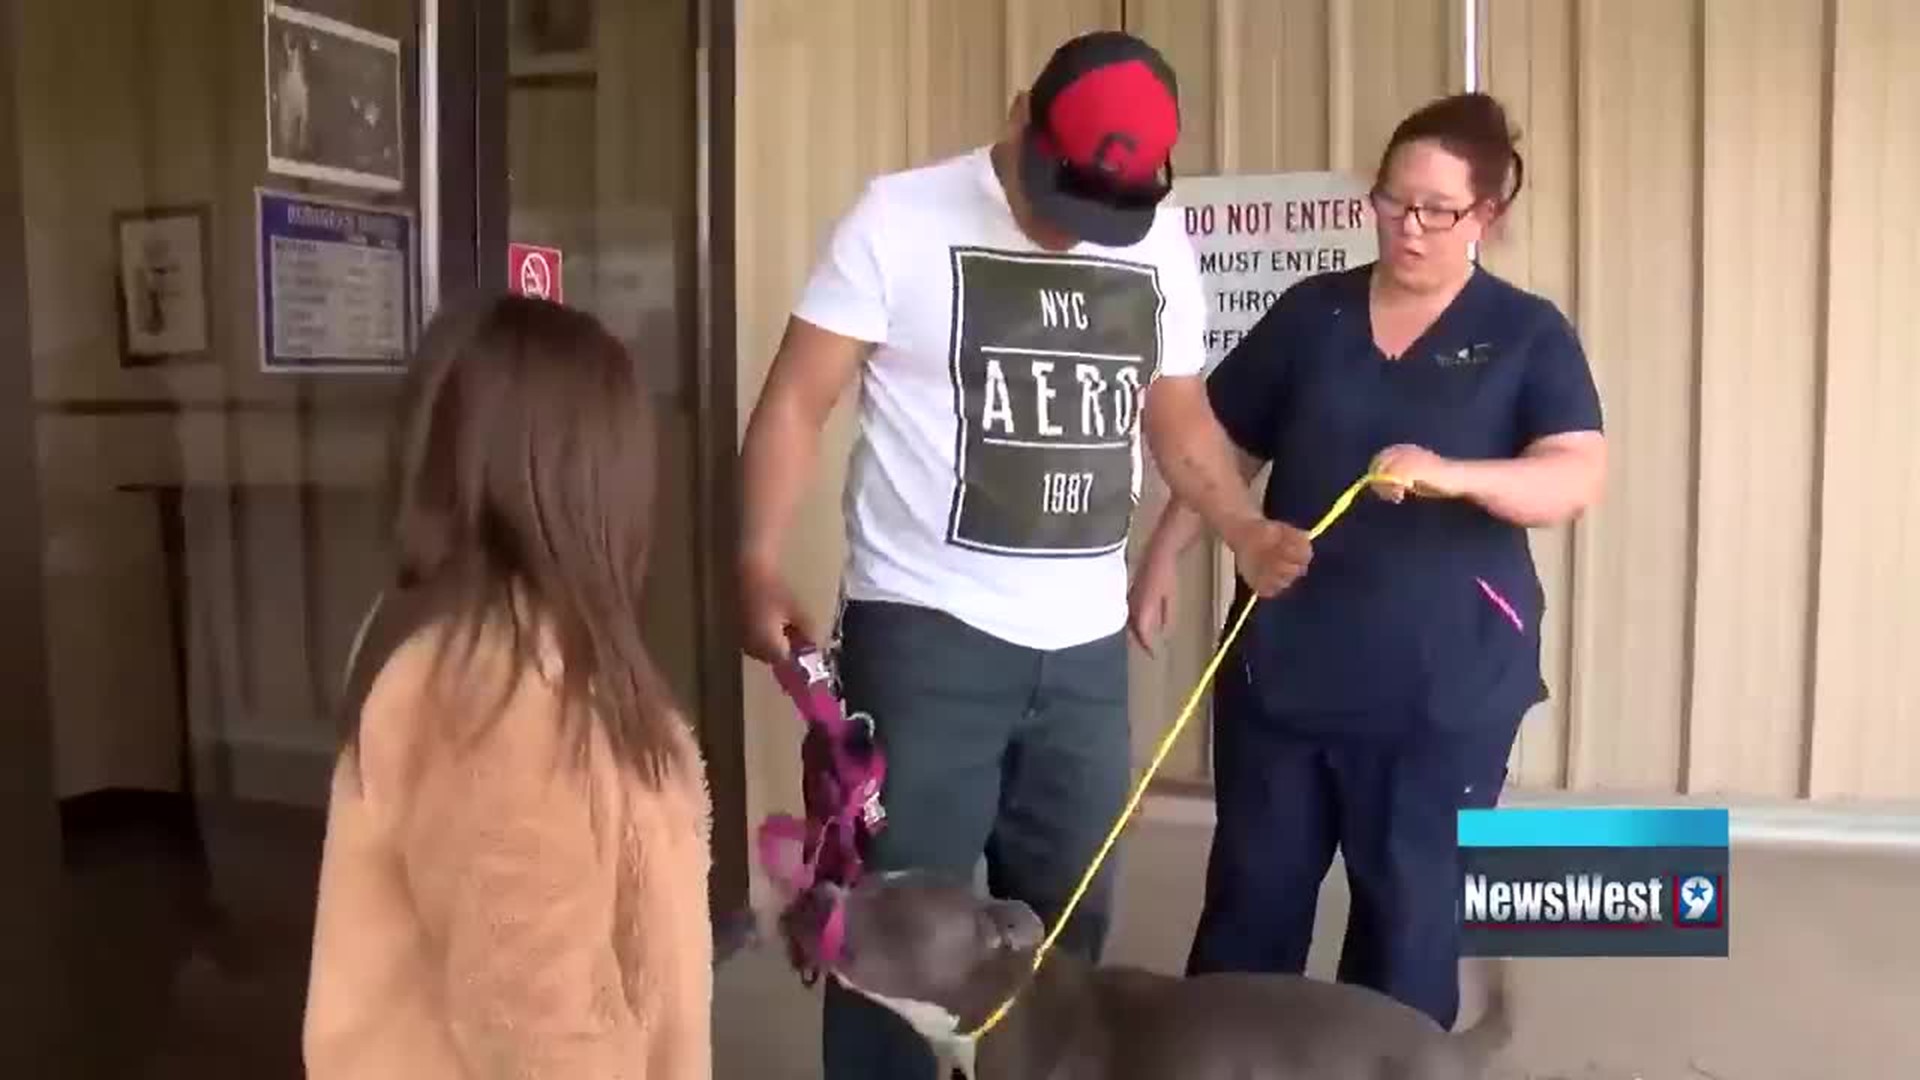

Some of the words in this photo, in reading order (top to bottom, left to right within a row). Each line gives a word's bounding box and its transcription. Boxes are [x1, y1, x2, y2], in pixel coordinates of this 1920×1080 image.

[1184, 205, 1214, 236] DO
[1227, 202, 1272, 236] NOT
[1285, 198, 1363, 233] ENTER
[1199, 250, 1263, 275] MUST
[1271, 247, 1347, 273] ENTER
[1040, 289, 1089, 331] NYC
[1217, 289, 1282, 313] THRO
[982, 359, 1141, 437] AERO
[1043, 472, 1094, 514] 1987
